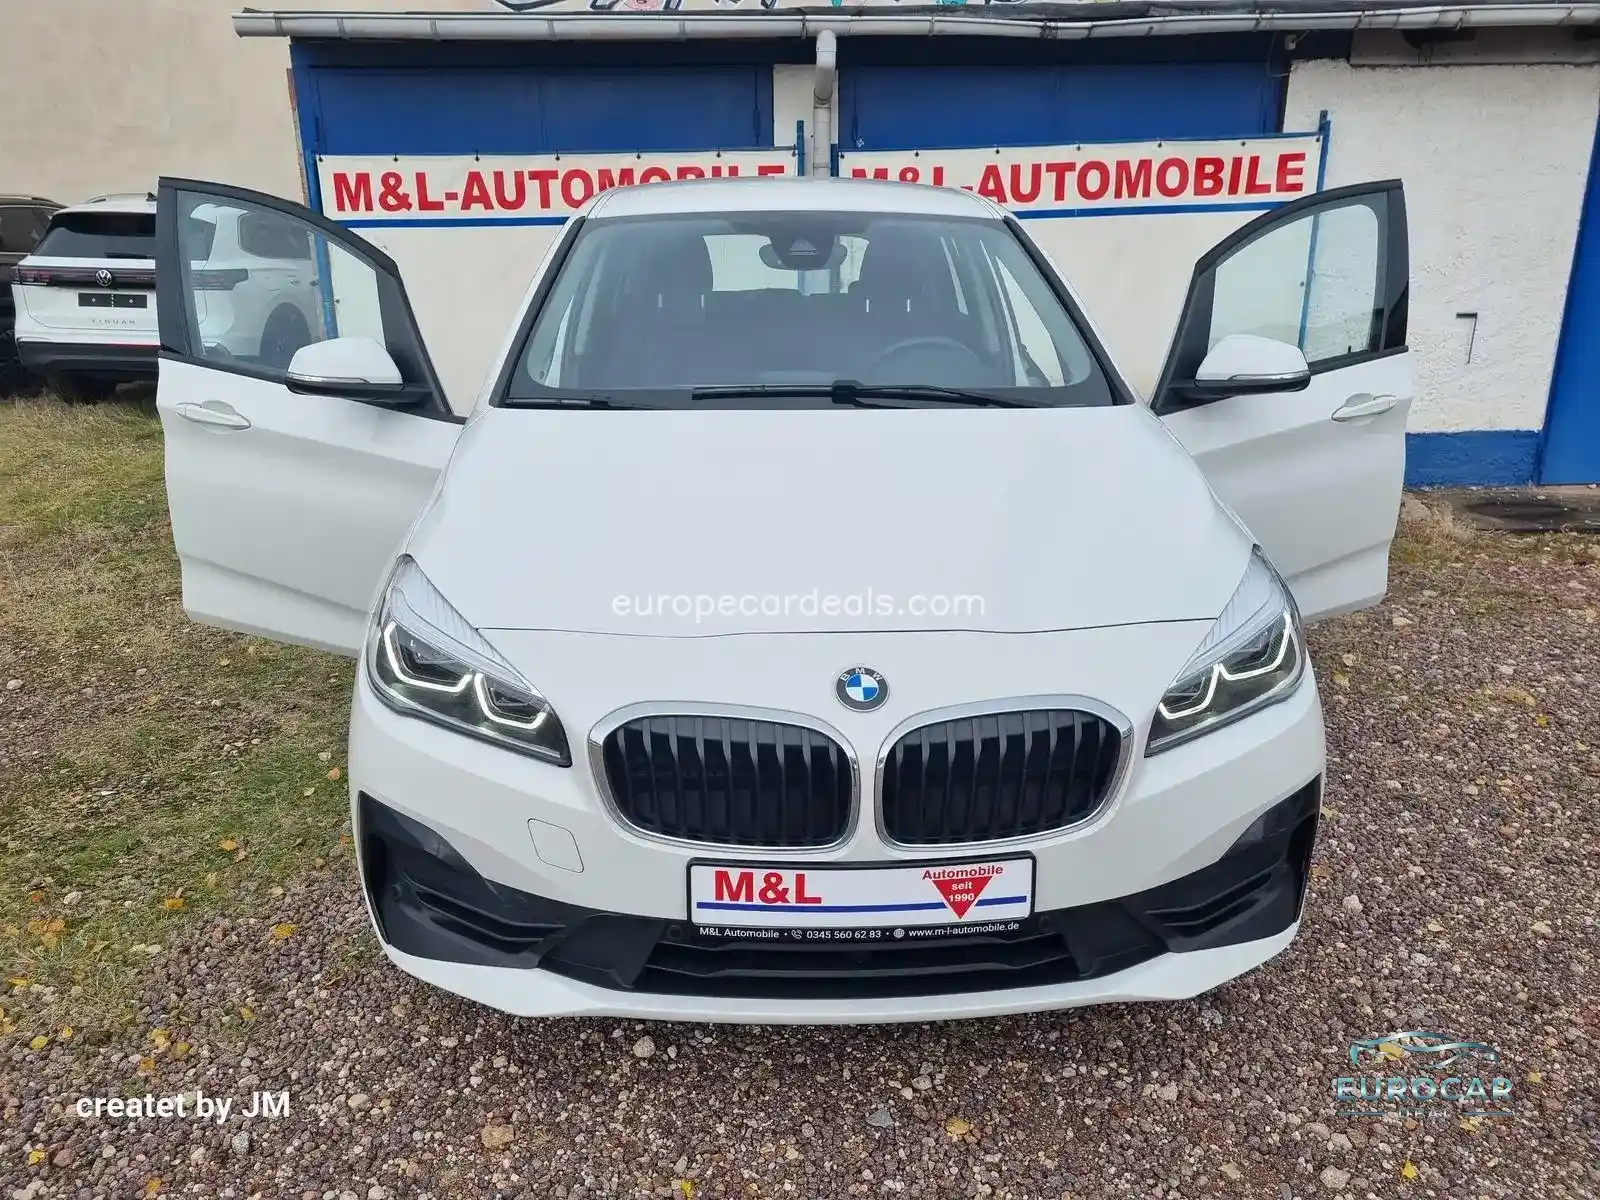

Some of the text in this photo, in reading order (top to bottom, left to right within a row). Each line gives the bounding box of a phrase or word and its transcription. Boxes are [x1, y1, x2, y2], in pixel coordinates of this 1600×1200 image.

[851, 152, 1307, 204] AUTOMOBILE
[333, 164, 785, 213] M&L-AUTOM
[840, 667, 883, 681] BMW
[922, 865, 1003, 880] Automobile
[714, 870, 822, 905] M&L
[951, 881, 973, 891] seit
[948, 893, 975, 903] 1990
[699, 922, 1019, 939] M&L Automobile 0345 560 62 83 www.m-l-automobile.de
